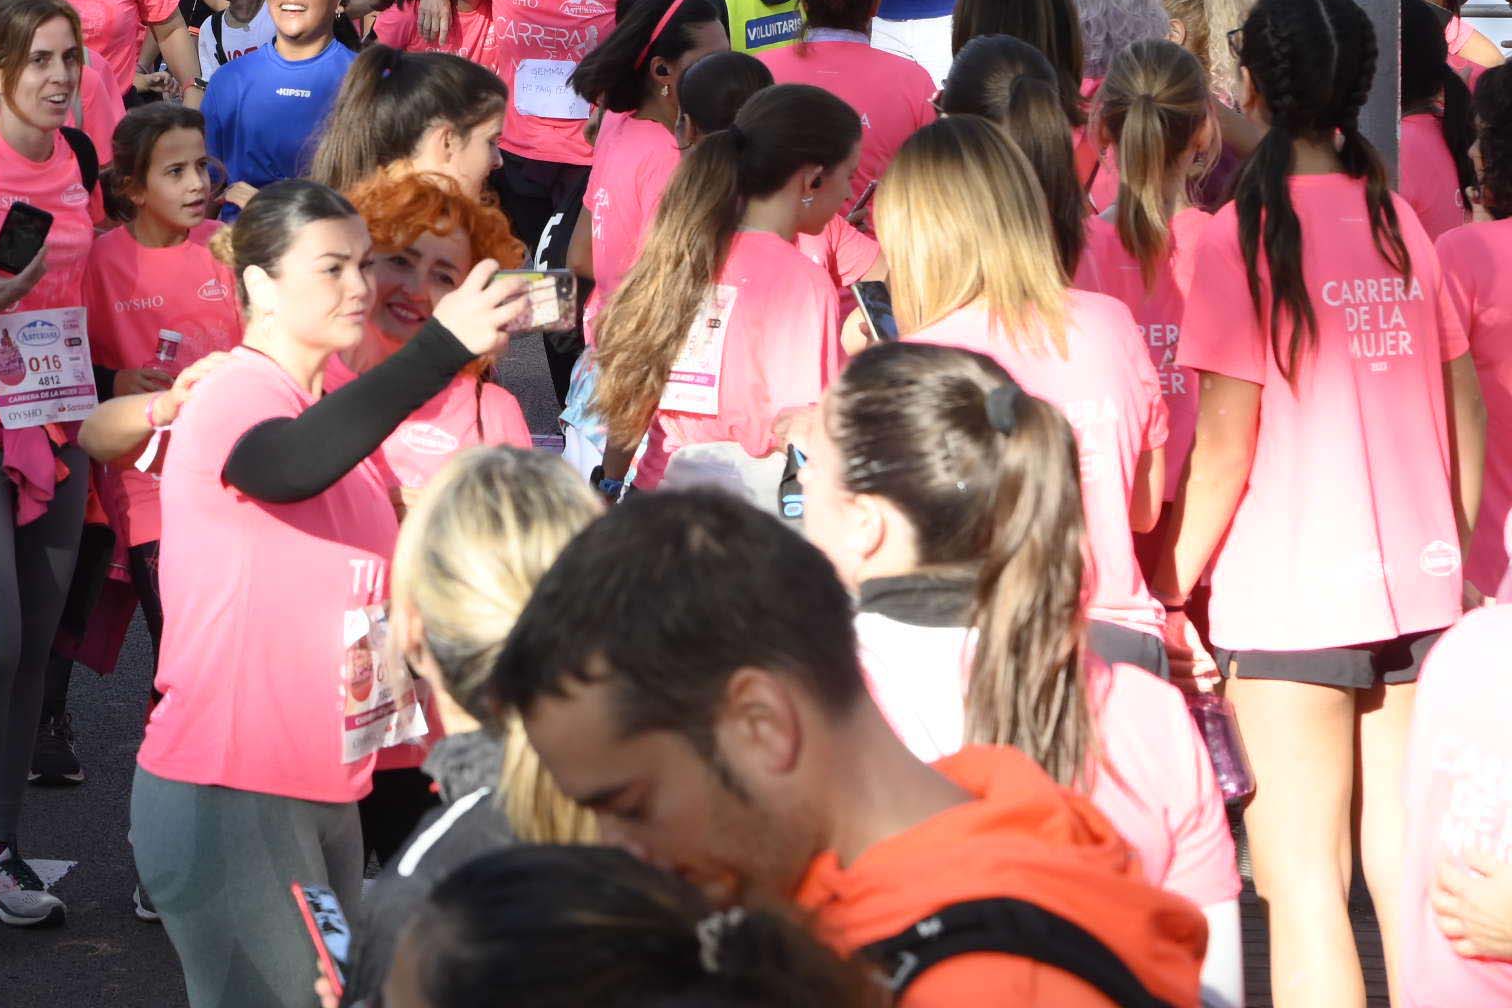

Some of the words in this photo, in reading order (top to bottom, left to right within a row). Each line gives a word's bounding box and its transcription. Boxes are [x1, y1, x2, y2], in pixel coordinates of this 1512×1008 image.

[495, 16, 582, 50] CARRERA
[1321, 276, 1424, 307] CARRERA
[114, 295, 165, 313] OYSHO
[1345, 306, 1371, 333] DE
[1378, 303, 1407, 330] LA
[1348, 330, 1415, 360] MUJER
[28, 354, 63, 373] 016
[38, 375, 61, 386] 4812
[8, 392, 40, 403] CARRERA
[8, 408, 43, 422] OYSHO
